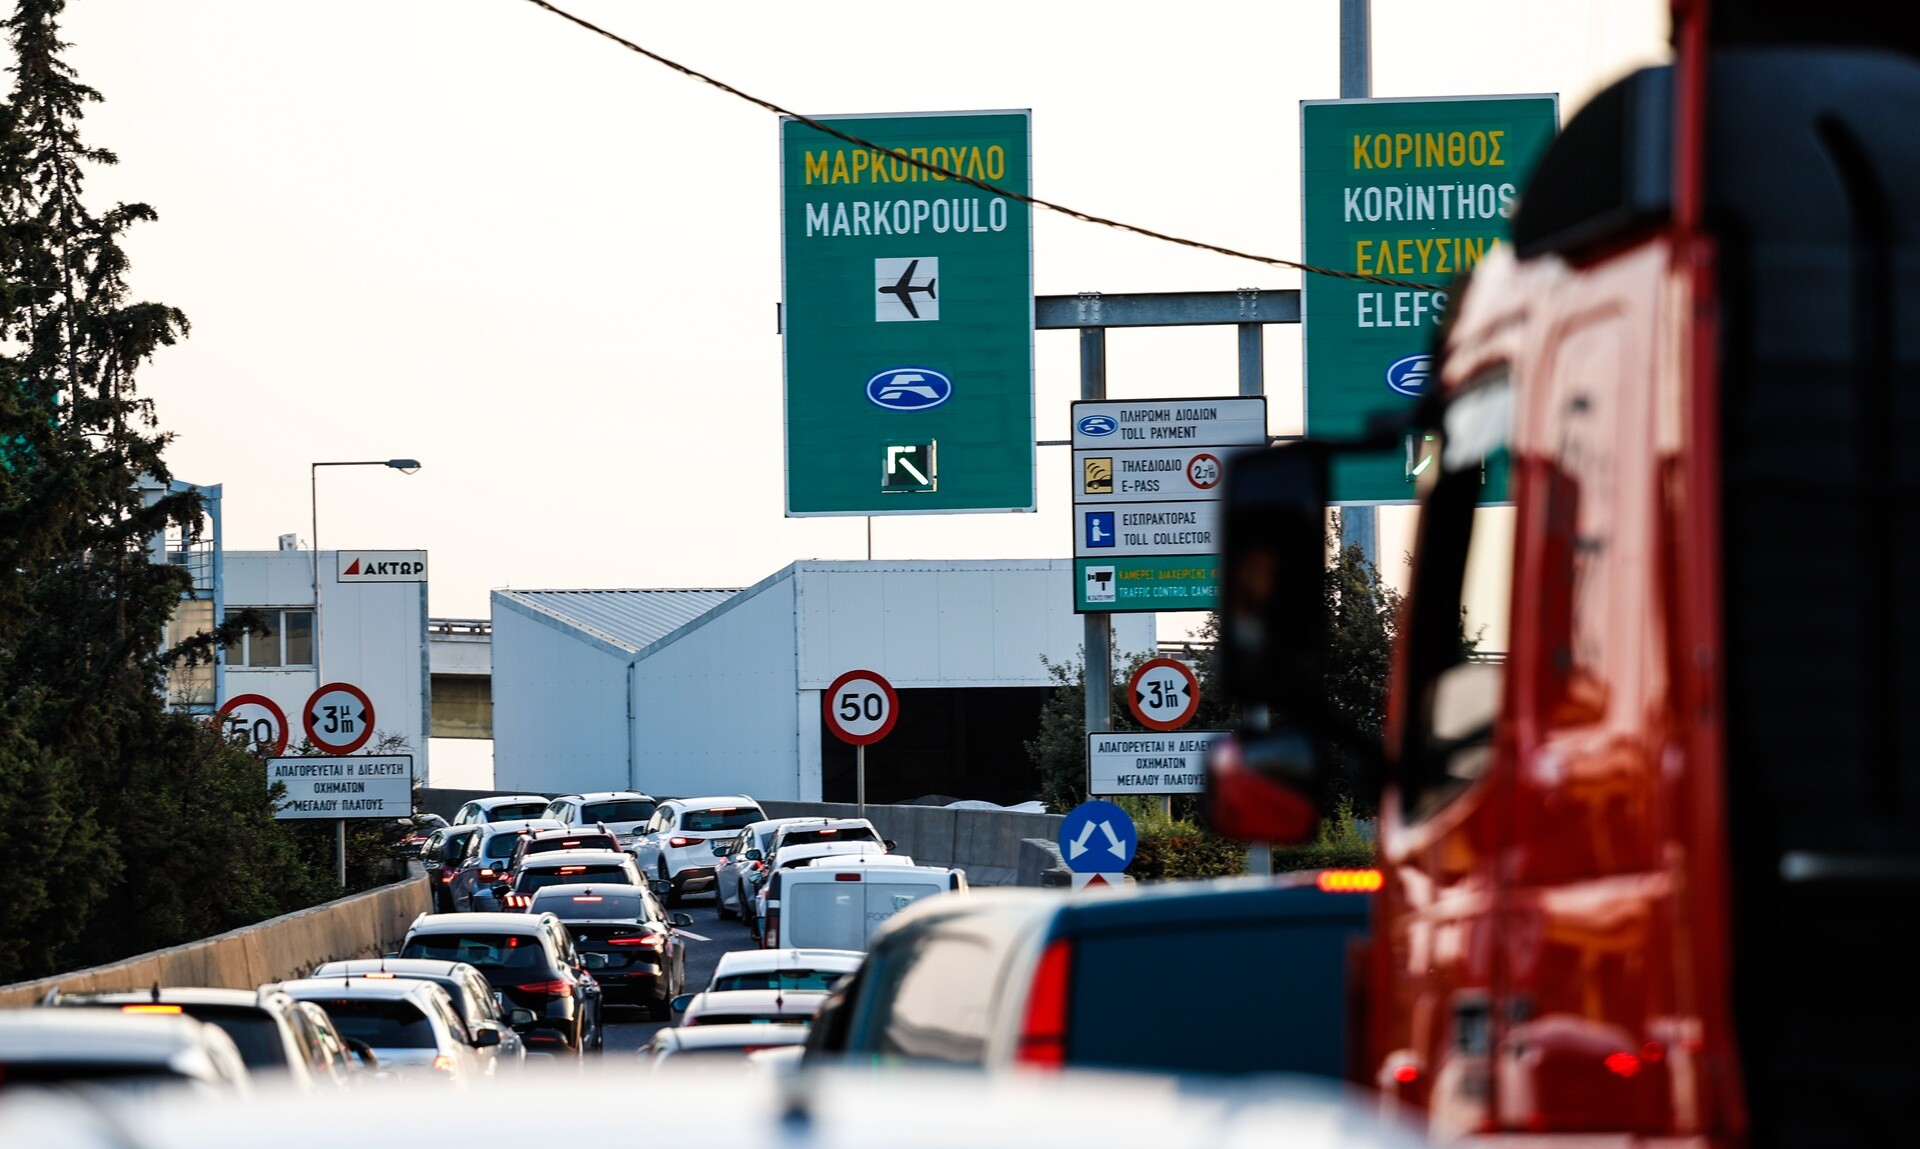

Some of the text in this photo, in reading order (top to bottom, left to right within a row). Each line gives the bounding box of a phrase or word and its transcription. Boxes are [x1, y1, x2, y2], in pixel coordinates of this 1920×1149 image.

[1353, 130, 1505, 170] ΚΟΡΙΝΘΟΣ
[805, 145, 1005, 185] ΜΑΡΚΟΠΟΥΛΟ
[1344, 183, 1517, 222] KORINTHOS
[806, 197, 1008, 237] MARKOPOULO
[1120, 408, 1217, 422] ΠΛΗΡΩΜΗ ΔΙΟΔΙΩΝ
[1120, 426, 1197, 440] TOLL PAYMENT
[1121, 459, 1182, 473] ΤΗΛΕΔΙΟΔΙΟ
[1121, 480, 1160, 492] E-PASS
[1123, 512, 1196, 526] ΕΙΣΠΡΑΚΤΟΡΑΣ
[1123, 532, 1211, 546] TOLL COLLECTOR
[364, 562, 424, 575] ΑΚΤΩΡ
[1119, 587, 1151, 598] TRAFFIC
[1153, 586, 1188, 597] CONTROL
[840, 693, 883, 721] 50
[1098, 741, 1165, 753] ΑΠΑΓΟΡΕΥΕΤΑΙ
[1168, 741, 1175, 752] Η
[275, 763, 403, 777] ΑΠΑΓΟΡΕΥΕΤΑΙ Η ΔΙΕΛΕΥΣΗ
[1136, 757, 1186, 769] ΟΧΗΜΑΤΩΝ
[1117, 774, 1159, 786] ΜΕΓΑΛΟΥ
[314, 782, 365, 794] ΟΧΗΜΑΤΩΝ
[294, 799, 384, 812] ΜΕΓΑΛΟΥ ΠΛΑΤΟΥΣ
